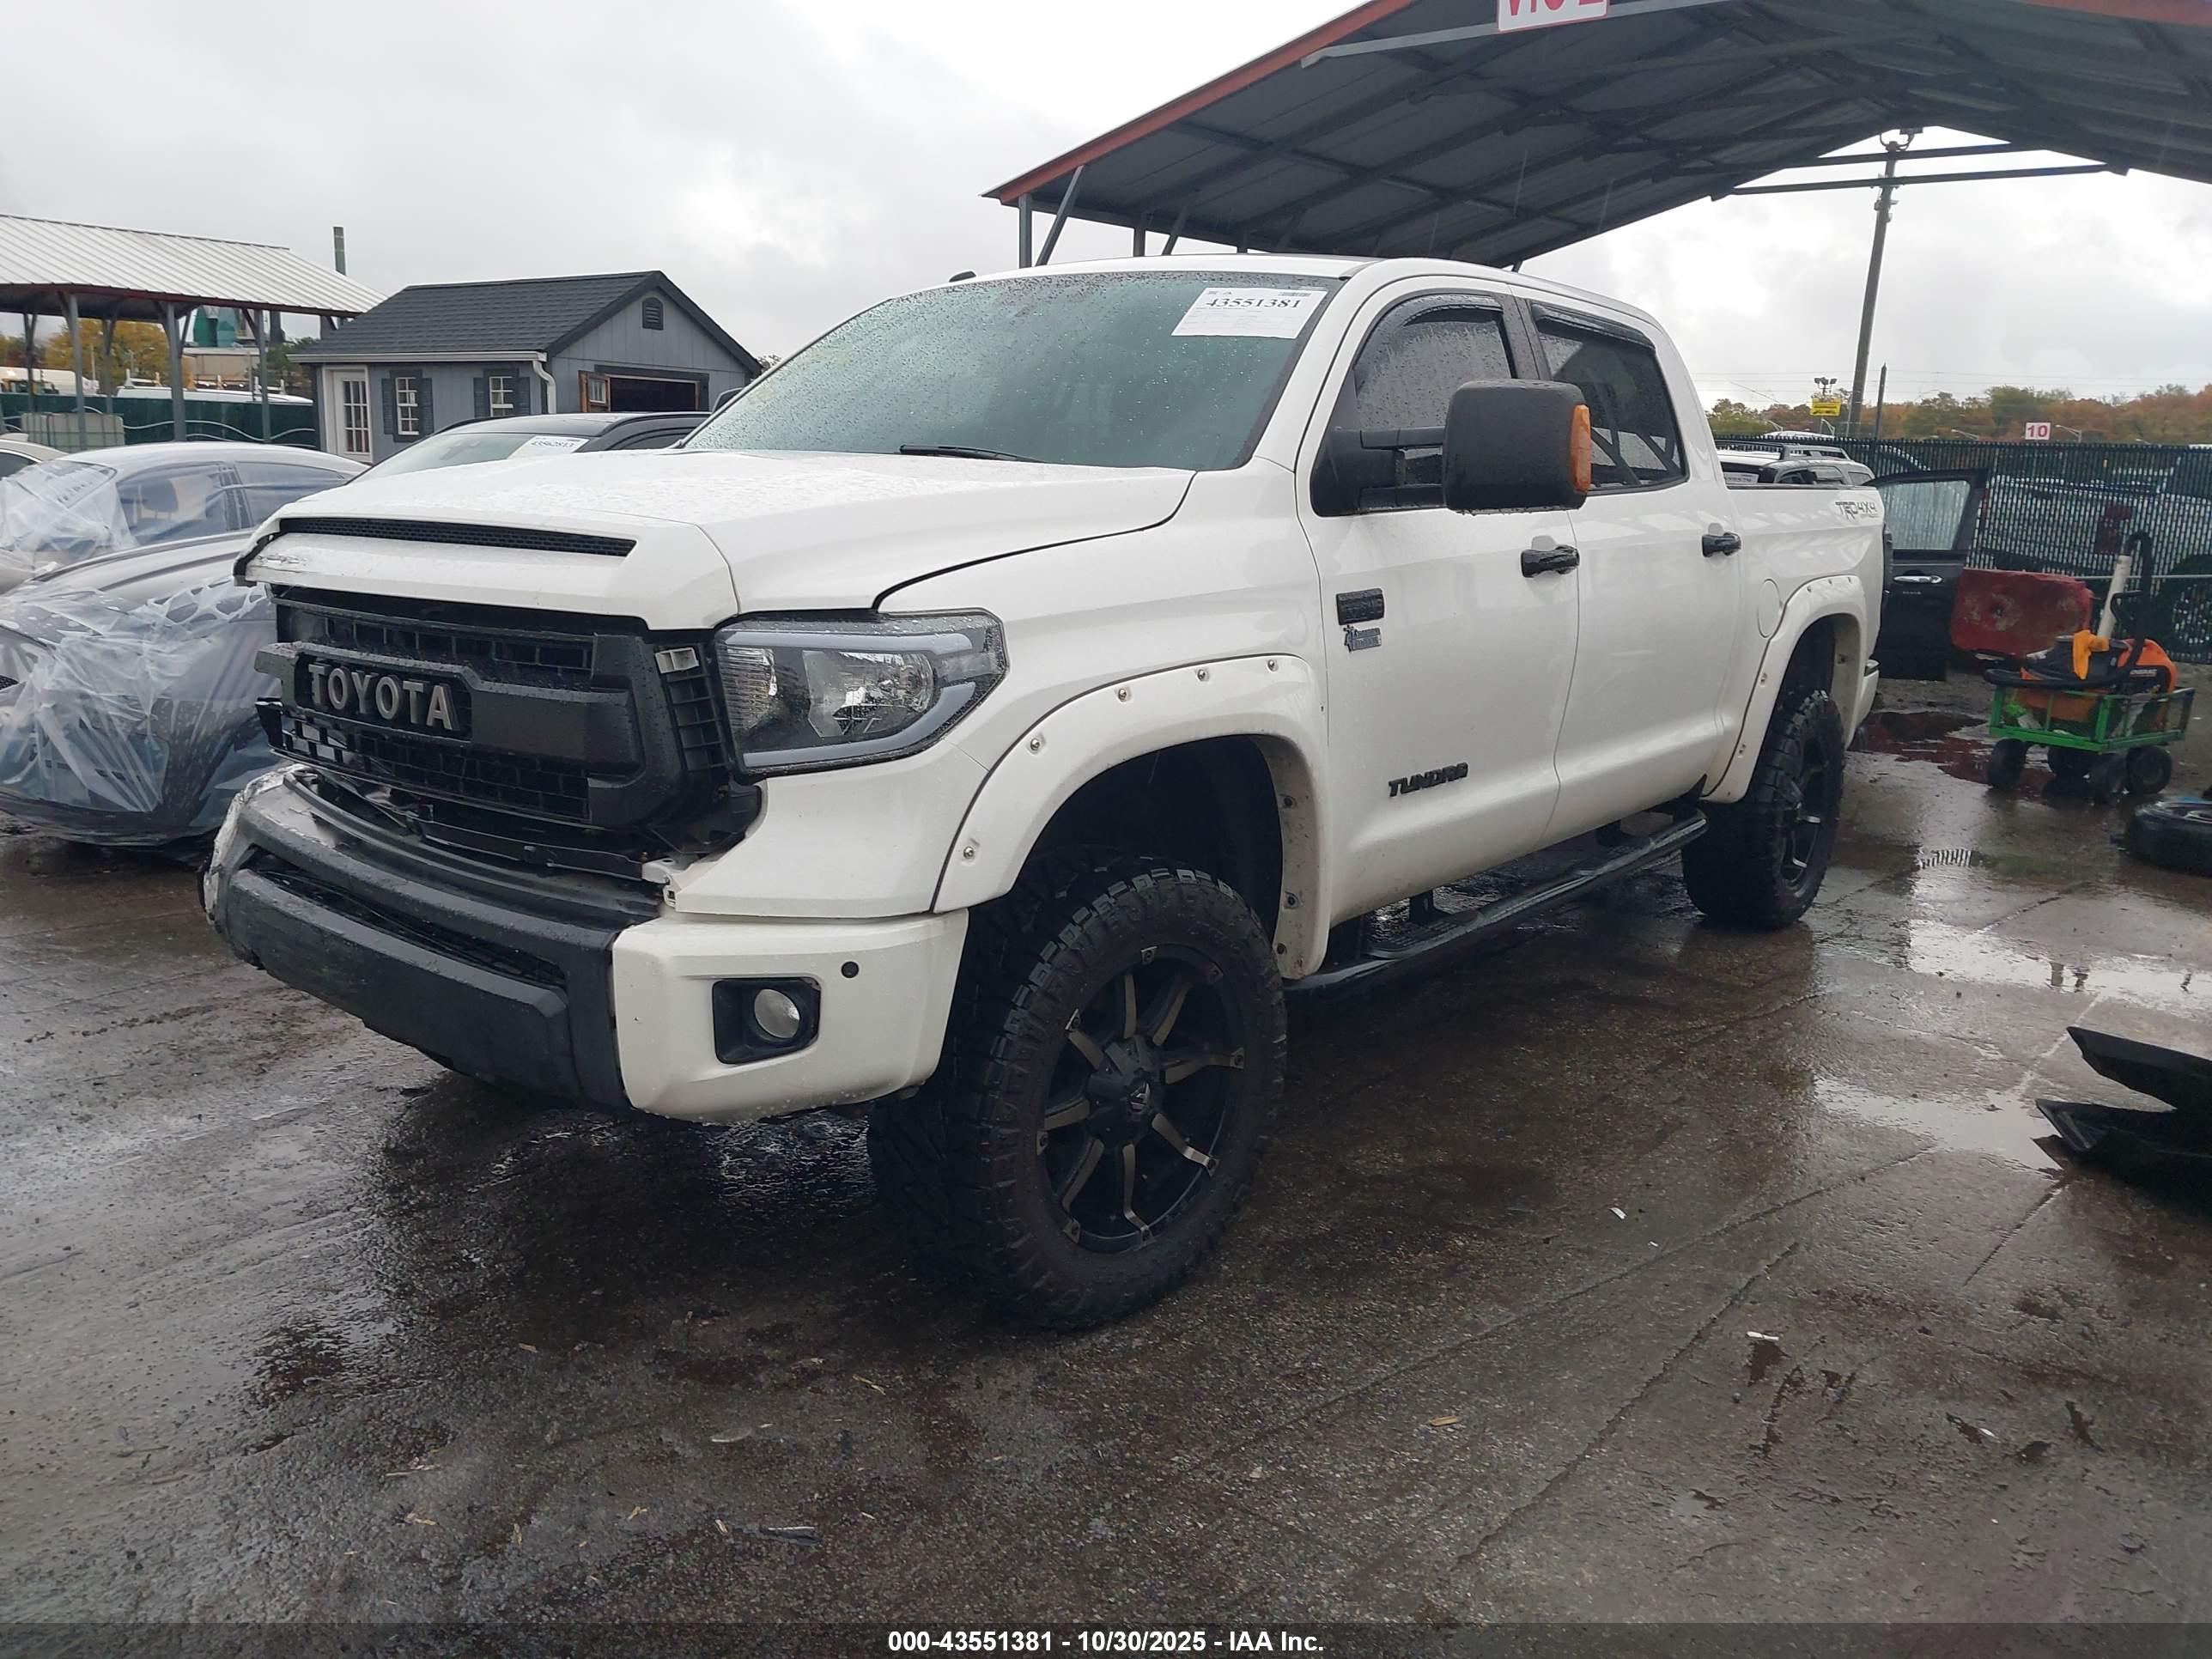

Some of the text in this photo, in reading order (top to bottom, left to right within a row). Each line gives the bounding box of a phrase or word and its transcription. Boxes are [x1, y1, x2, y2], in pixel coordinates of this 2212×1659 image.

[1206, 298, 1302, 308] 43551381
[2027, 425, 2048, 437] 10
[1835, 501, 1857, 520] TRD
[308, 664, 456, 731] TOYOTA
[1388, 762, 1468, 798] TUNDRA
